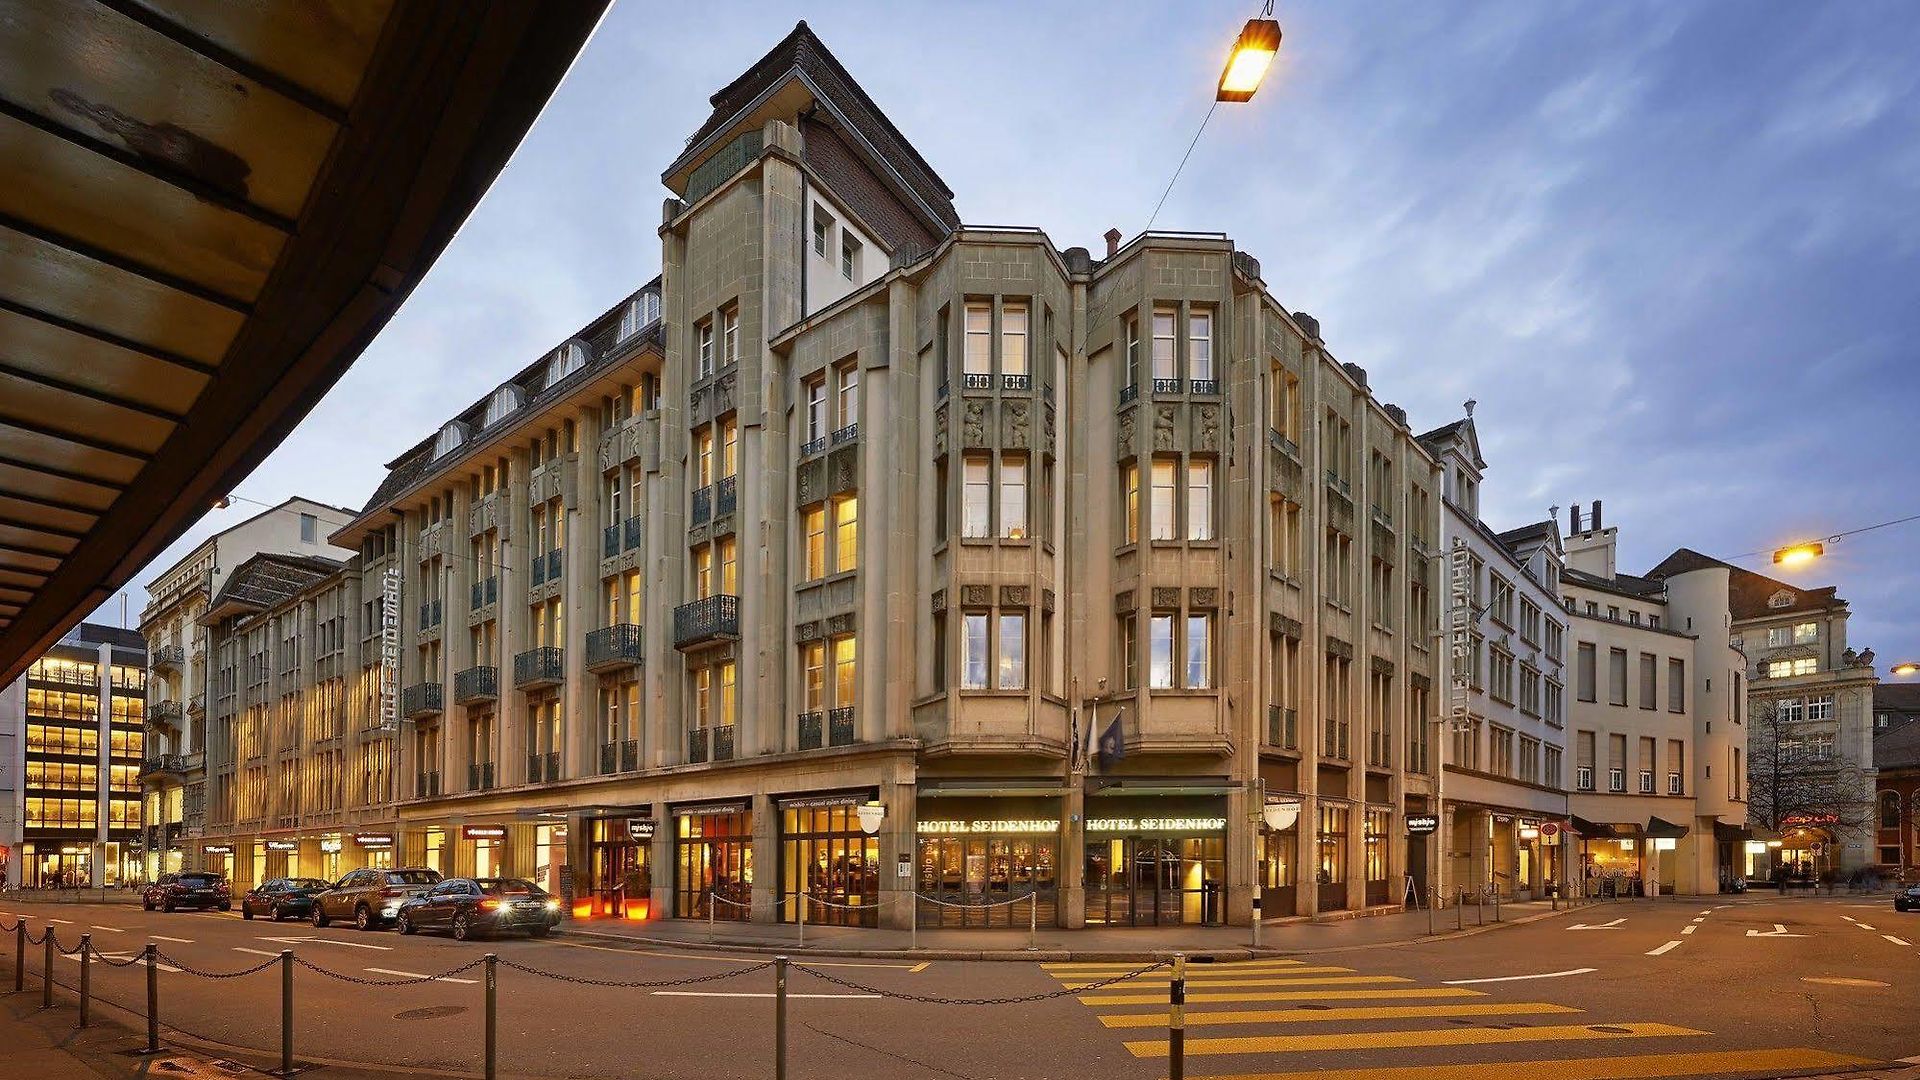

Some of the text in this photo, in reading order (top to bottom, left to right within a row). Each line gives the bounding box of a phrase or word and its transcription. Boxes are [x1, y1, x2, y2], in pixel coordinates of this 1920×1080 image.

[916, 820, 1061, 833] HOTEL SEIDENHOF
[1086, 818, 1227, 831] HOTEL SEIDENHOF
